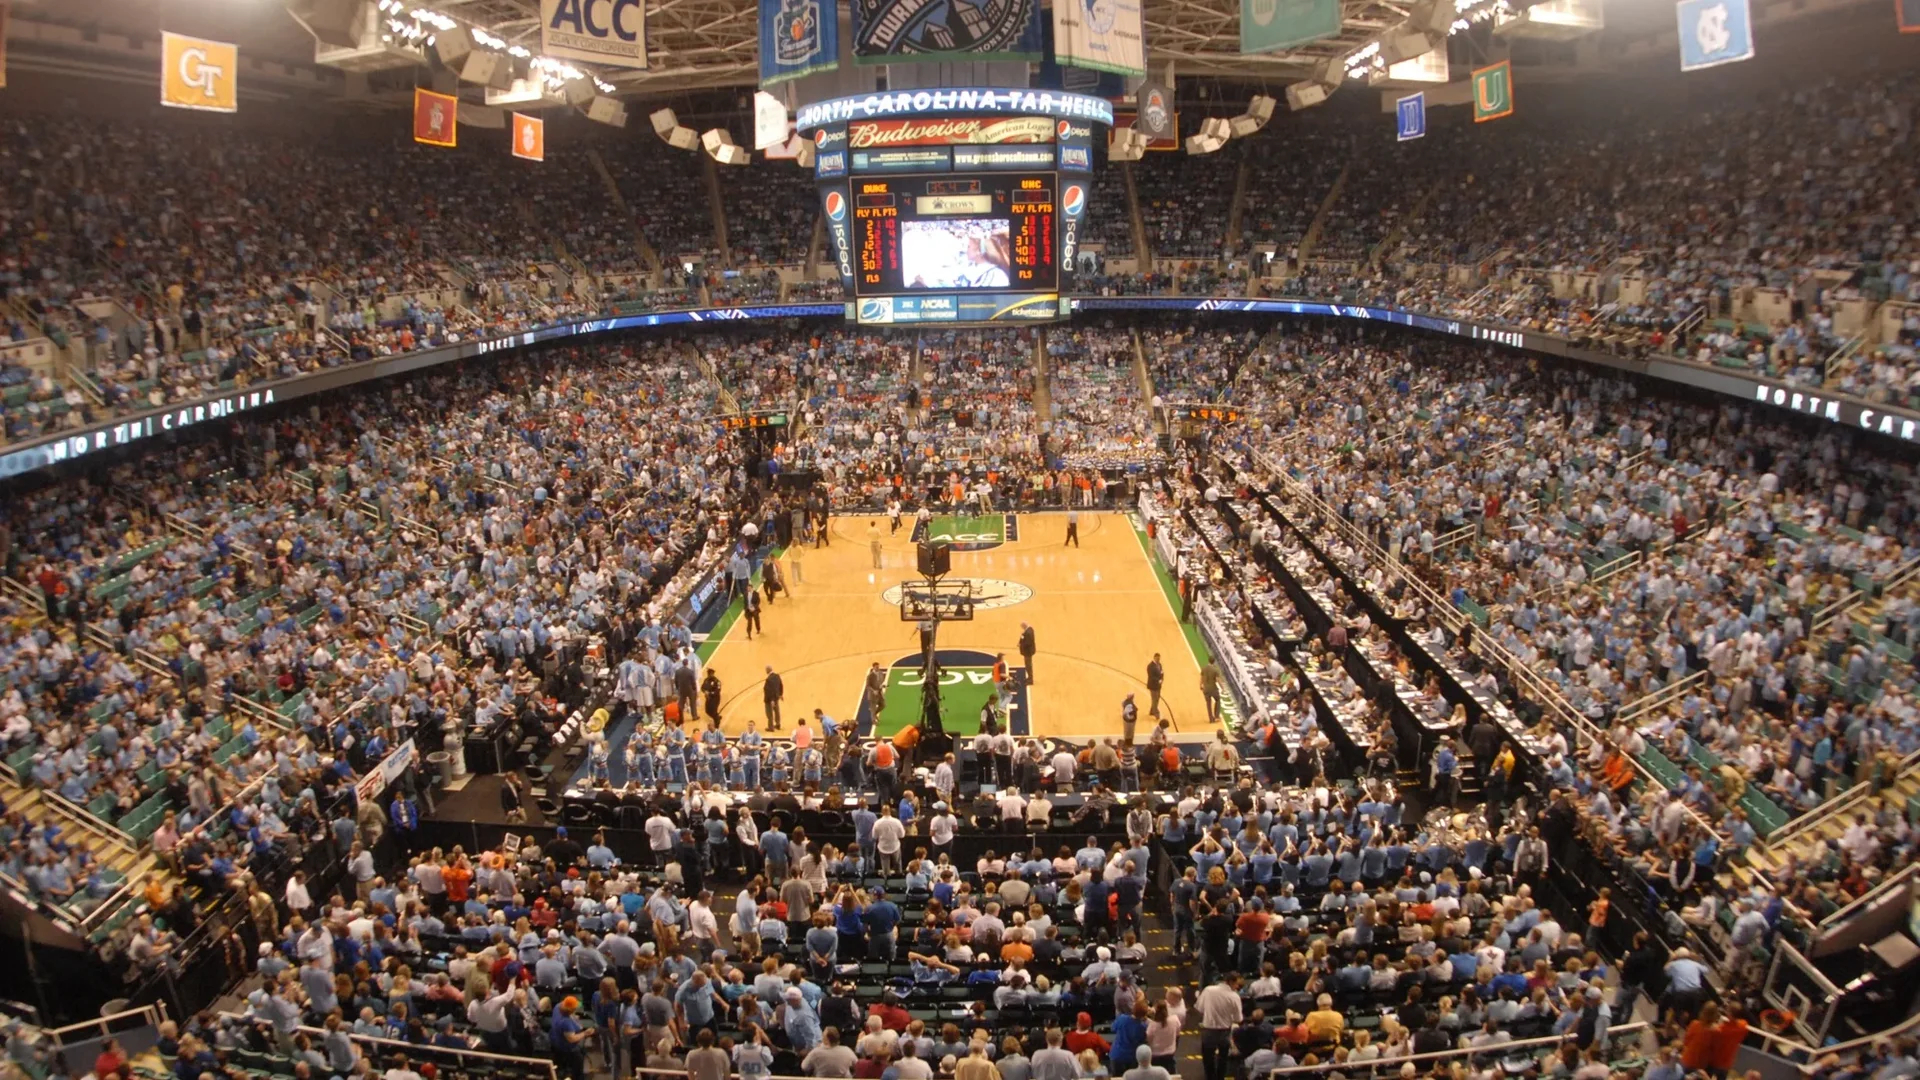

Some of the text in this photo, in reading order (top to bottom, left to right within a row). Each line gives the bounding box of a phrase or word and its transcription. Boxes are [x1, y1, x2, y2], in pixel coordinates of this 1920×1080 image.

[550, 0, 640, 41] ACC
[179, 48, 223, 97] GT
[805, 99, 854, 124] NORTH
[1010, 91, 1052, 113] TAR
[1061, 95, 1104, 118] HEELS
[827, 130, 846, 143] pepsi
[850, 119, 981, 147] Budweiser
[985, 124, 1025, 141] American
[1071, 127, 1090, 138] pepsi
[863, 184, 887, 193] DUKE
[1021, 180, 1042, 189] UNC
[833, 224, 853, 276] pepsi
[1015, 246, 1028, 256] 40
[1063, 219, 1076, 271] pepsi
[863, 261, 875, 270] 30
[921, 299, 952, 309] NCAA
[1012, 308, 1056, 318] ticketmaster
[1482, 328, 1512, 344] DUKE
[1756, 385, 1840, 422] NORTH
[54, 389, 274, 460] NORTH CAROLINA
[931, 533, 999, 541] ACC
[898, 671, 993, 685] ACC
